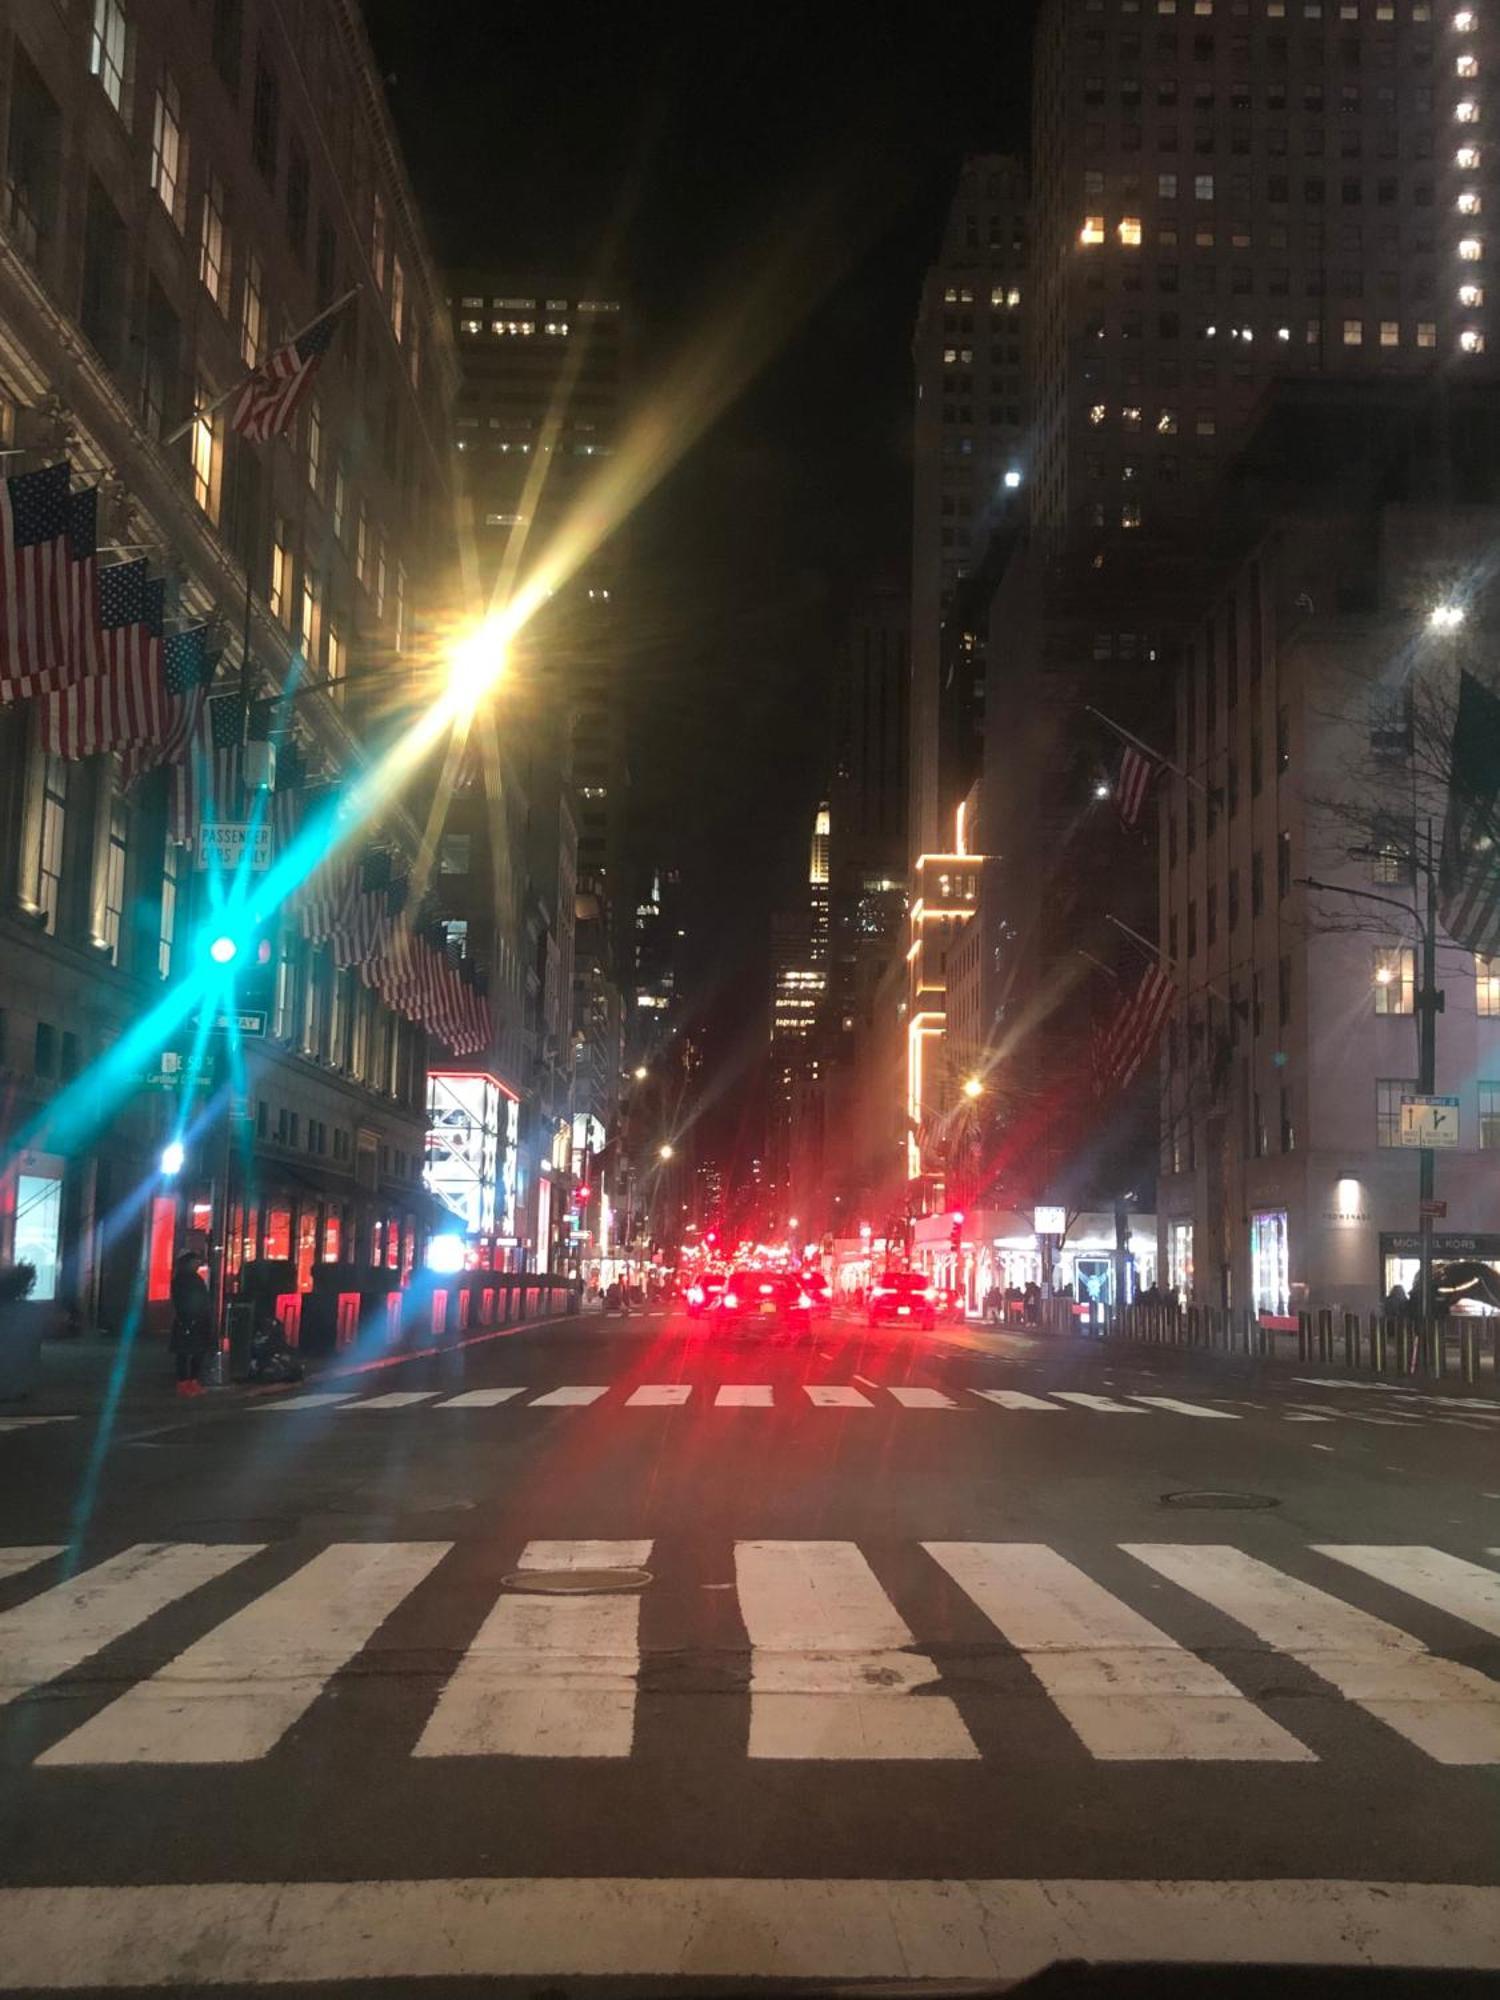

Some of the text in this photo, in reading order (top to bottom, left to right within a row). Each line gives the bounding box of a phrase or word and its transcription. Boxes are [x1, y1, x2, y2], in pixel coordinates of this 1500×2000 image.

[202, 829, 268, 844] PASSENER
[201, 848, 267, 864] CRS OLY
[1393, 1238, 1476, 1249] MICHEL KORS
